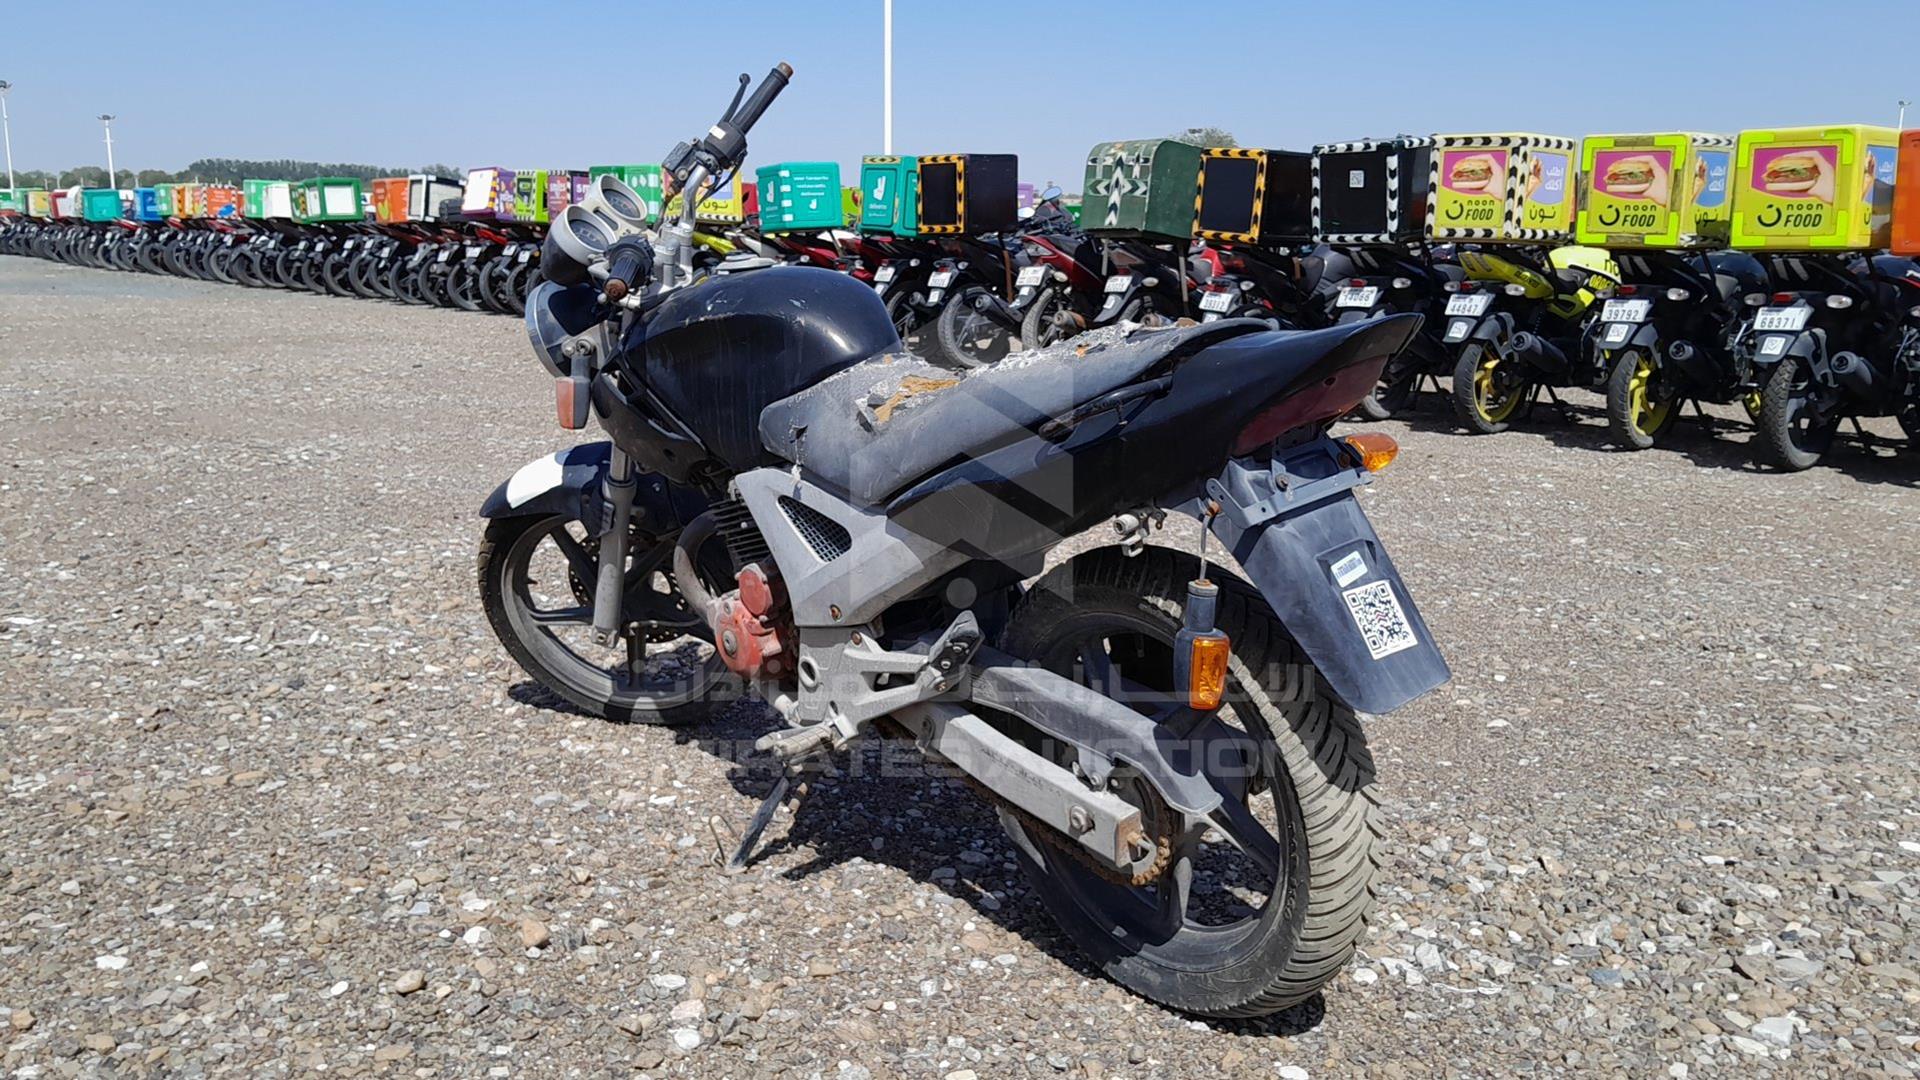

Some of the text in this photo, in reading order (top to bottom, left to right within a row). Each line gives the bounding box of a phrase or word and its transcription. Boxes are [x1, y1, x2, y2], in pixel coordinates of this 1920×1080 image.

[1624, 204, 1657, 212] noon
[1786, 203, 1824, 211] noon
[1465, 208, 1494, 221] FOOD
[1529, 205, 1556, 224] نون
[1783, 213, 1823, 228] FOOD
[1622, 214, 1656, 228] FOOD
[1450, 303, 1479, 314] 44847
[1606, 309, 1639, 321] 39792
